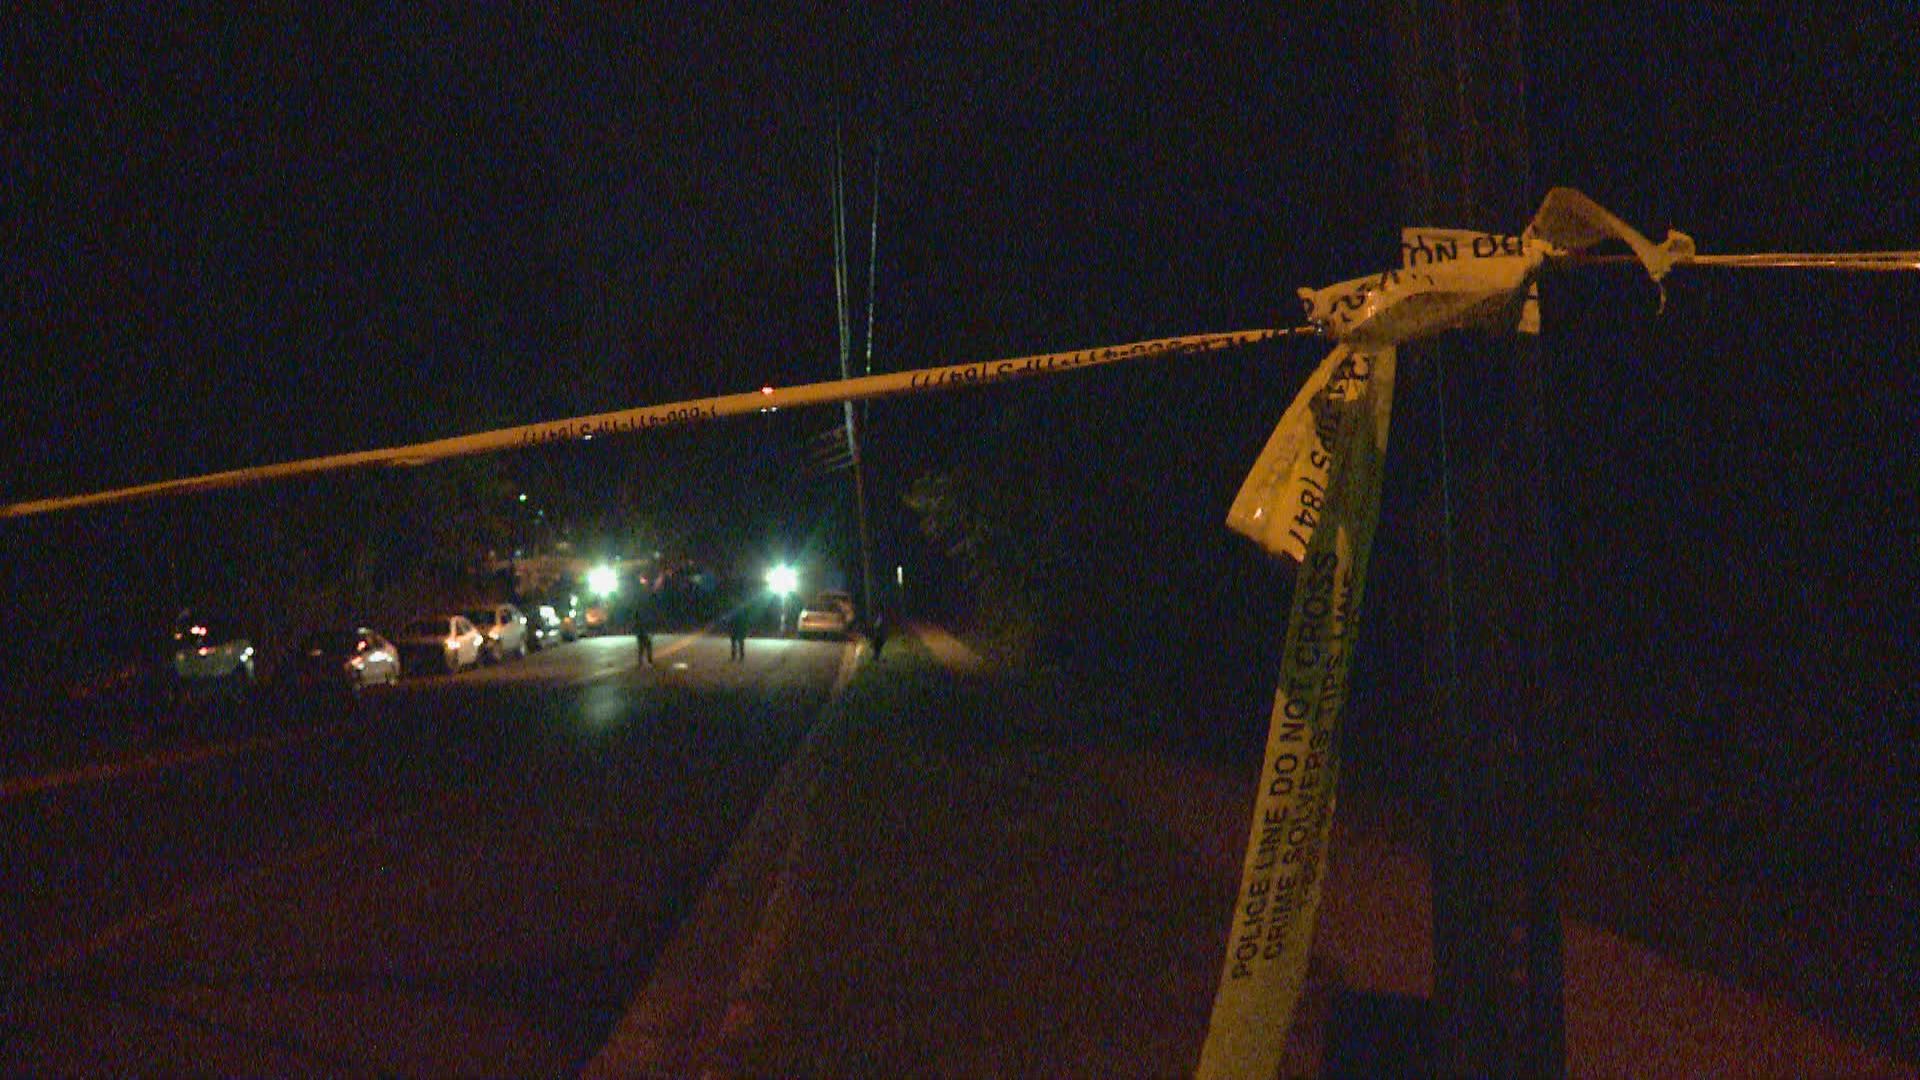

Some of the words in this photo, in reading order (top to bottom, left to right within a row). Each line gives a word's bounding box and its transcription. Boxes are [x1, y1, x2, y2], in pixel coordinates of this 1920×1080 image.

[1295, 551, 1339, 668] CROSS
[1279, 676, 1312, 743] NOT
[1268, 752, 1298, 797] DO
[1254, 806, 1288, 871] LINE
[1263, 876, 1298, 961] CRIME
[1282, 728, 1330, 865] SOLVERS
[1231, 876, 1270, 980] POLICE
